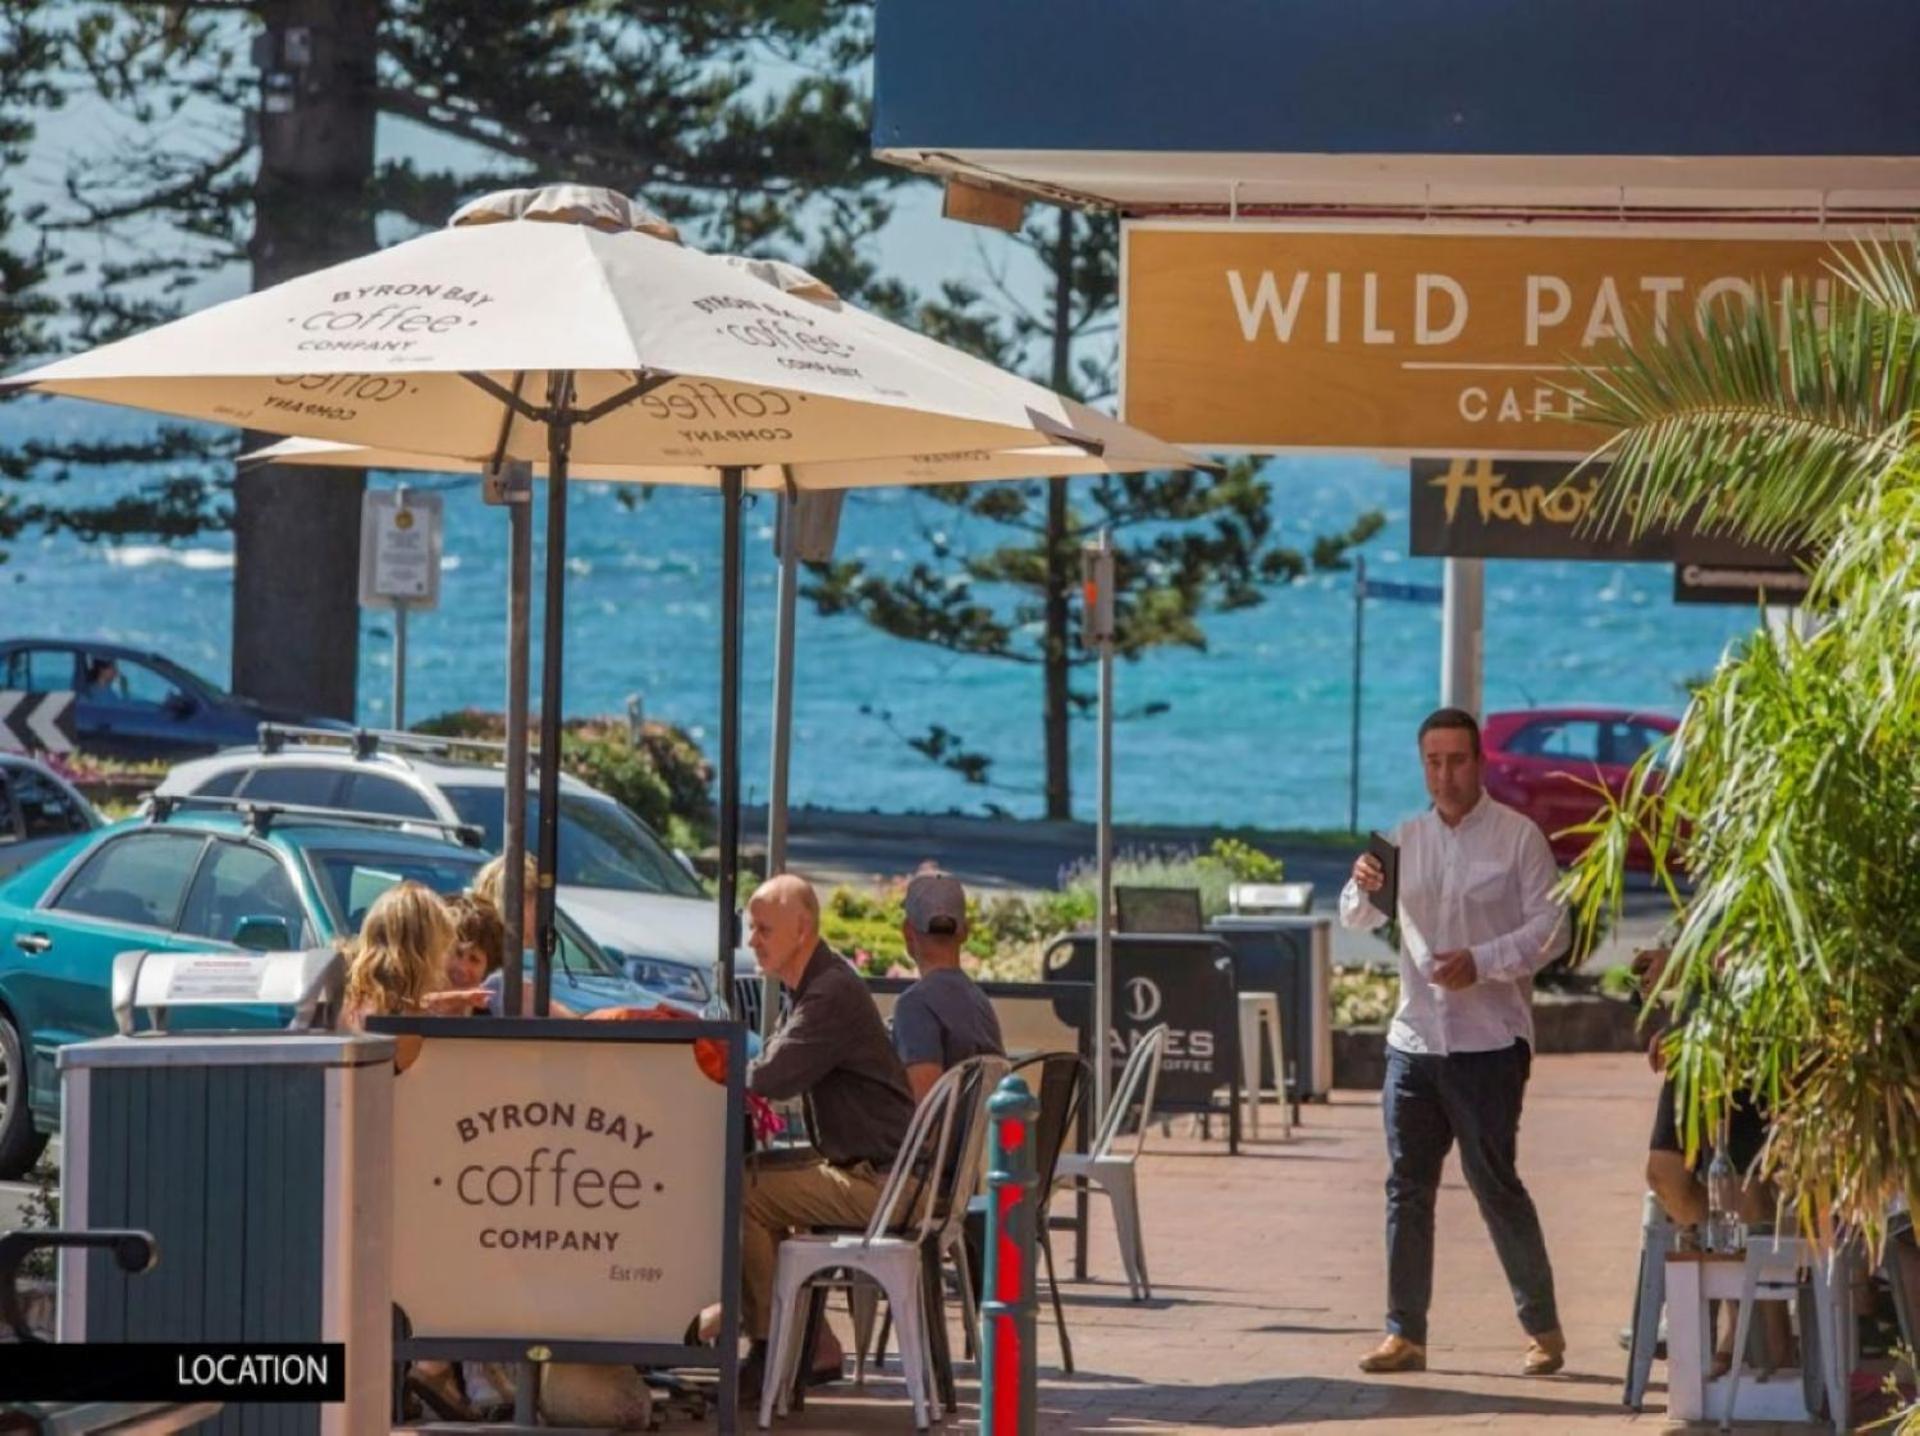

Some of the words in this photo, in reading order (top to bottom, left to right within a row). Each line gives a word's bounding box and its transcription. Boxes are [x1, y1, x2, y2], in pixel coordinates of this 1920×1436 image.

[332, 284, 442, 303] BYRON
[442, 286, 494, 307] BAY
[1226, 269, 1470, 346] WILD
[302, 304, 462, 334] coffee
[297, 340, 418, 352] COMPANY
[727, 318, 851, 359] coffee
[456, 1101, 576, 1144] BYRON
[585, 1106, 654, 1150] BAY
[456, 1147, 643, 1211] coffee
[479, 1228, 620, 1252] COMPANY
